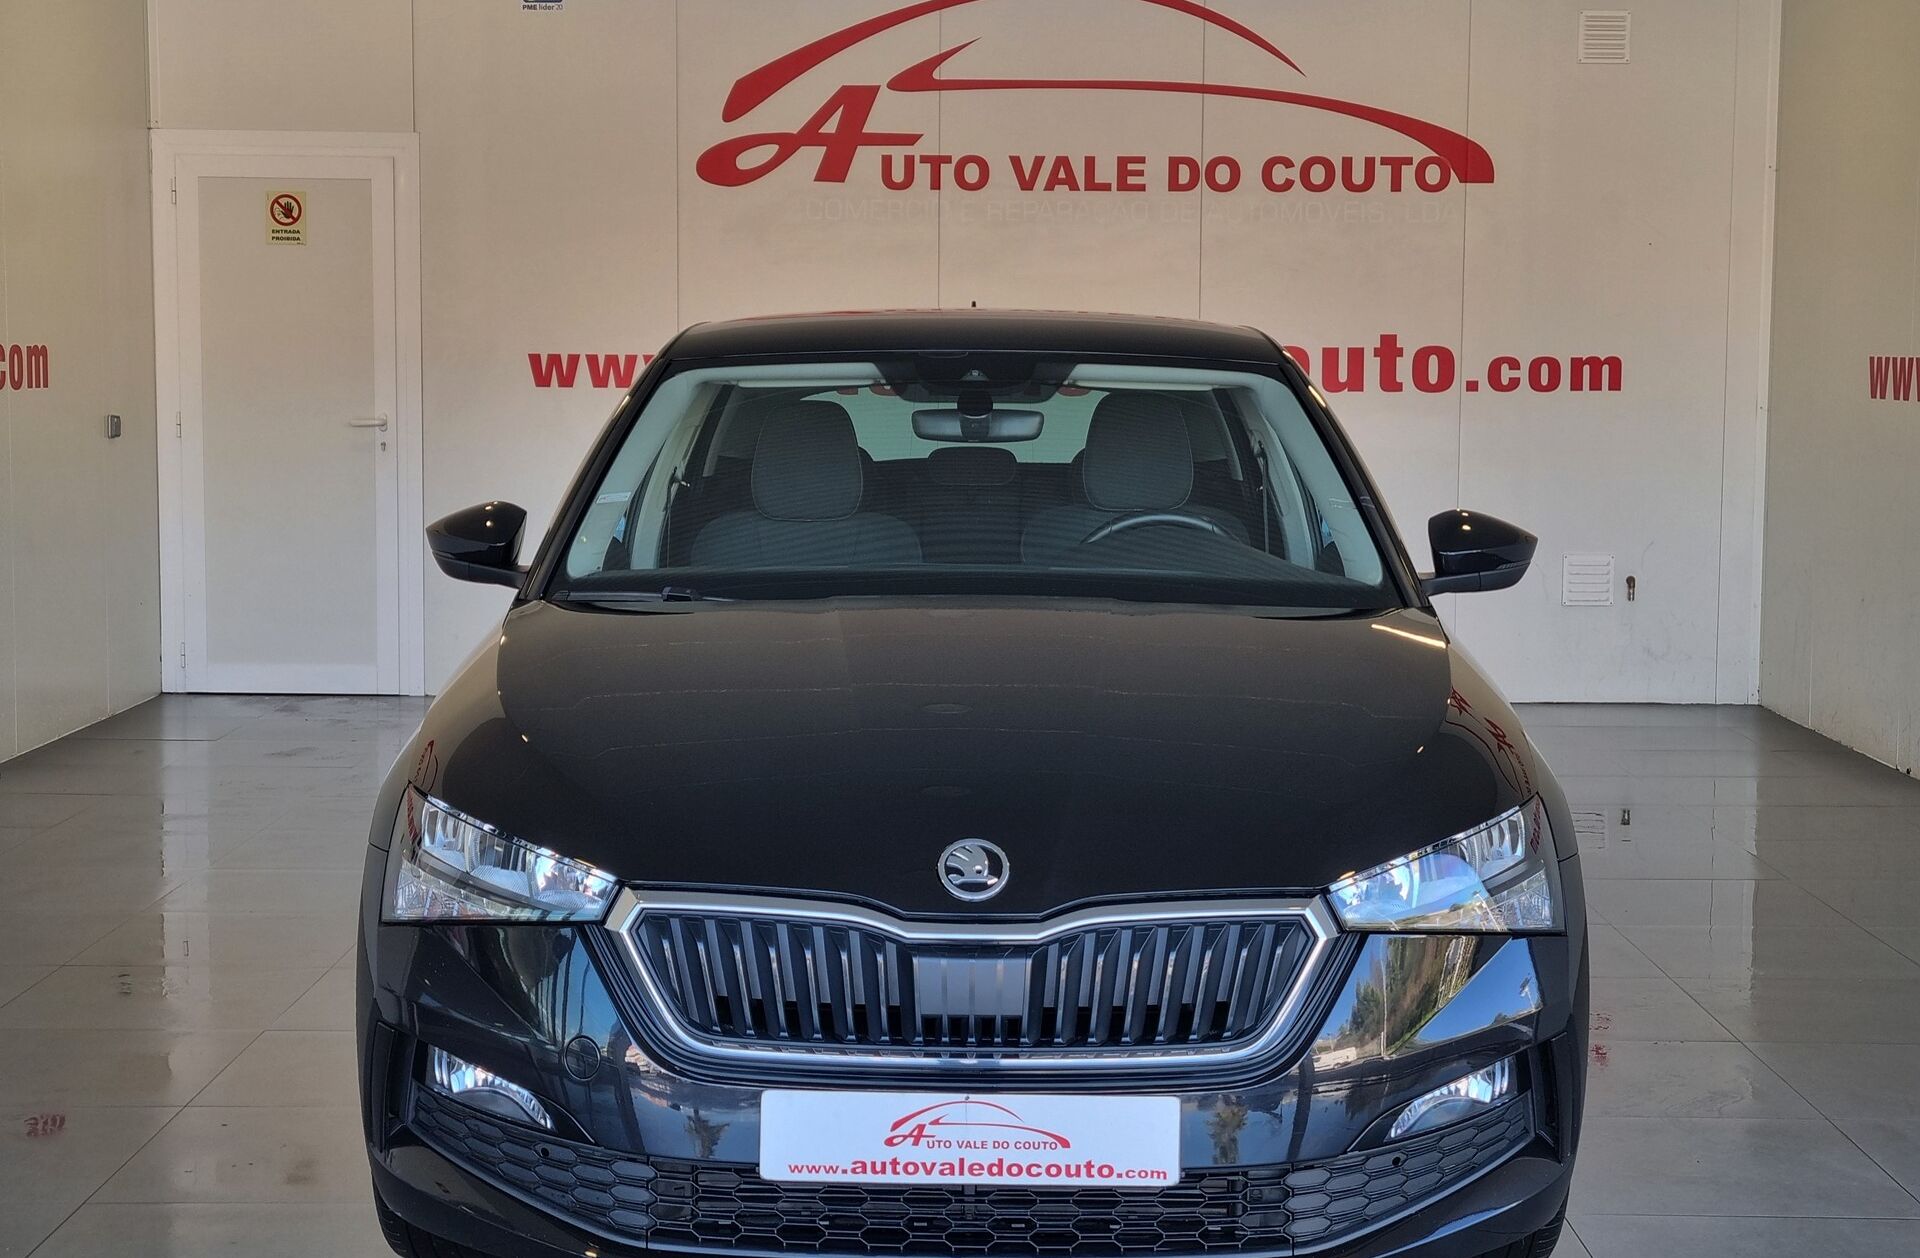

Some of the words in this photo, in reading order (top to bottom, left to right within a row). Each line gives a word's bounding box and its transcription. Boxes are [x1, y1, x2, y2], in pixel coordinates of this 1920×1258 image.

[1008, 155, 1147, 192] VALE
[1167, 155, 1242, 193] DO
[1260, 155, 1452, 193] COUTO
[528, 353, 657, 388] ww
[1869, 356, 1920, 402] ww
[957, 1140, 988, 1149] VALE
[992, 1140, 1010, 1149] DO
[1014, 1141, 1058, 1150] COUTO
[788, 1156, 1168, 1180] www.autovaledocouto.com
